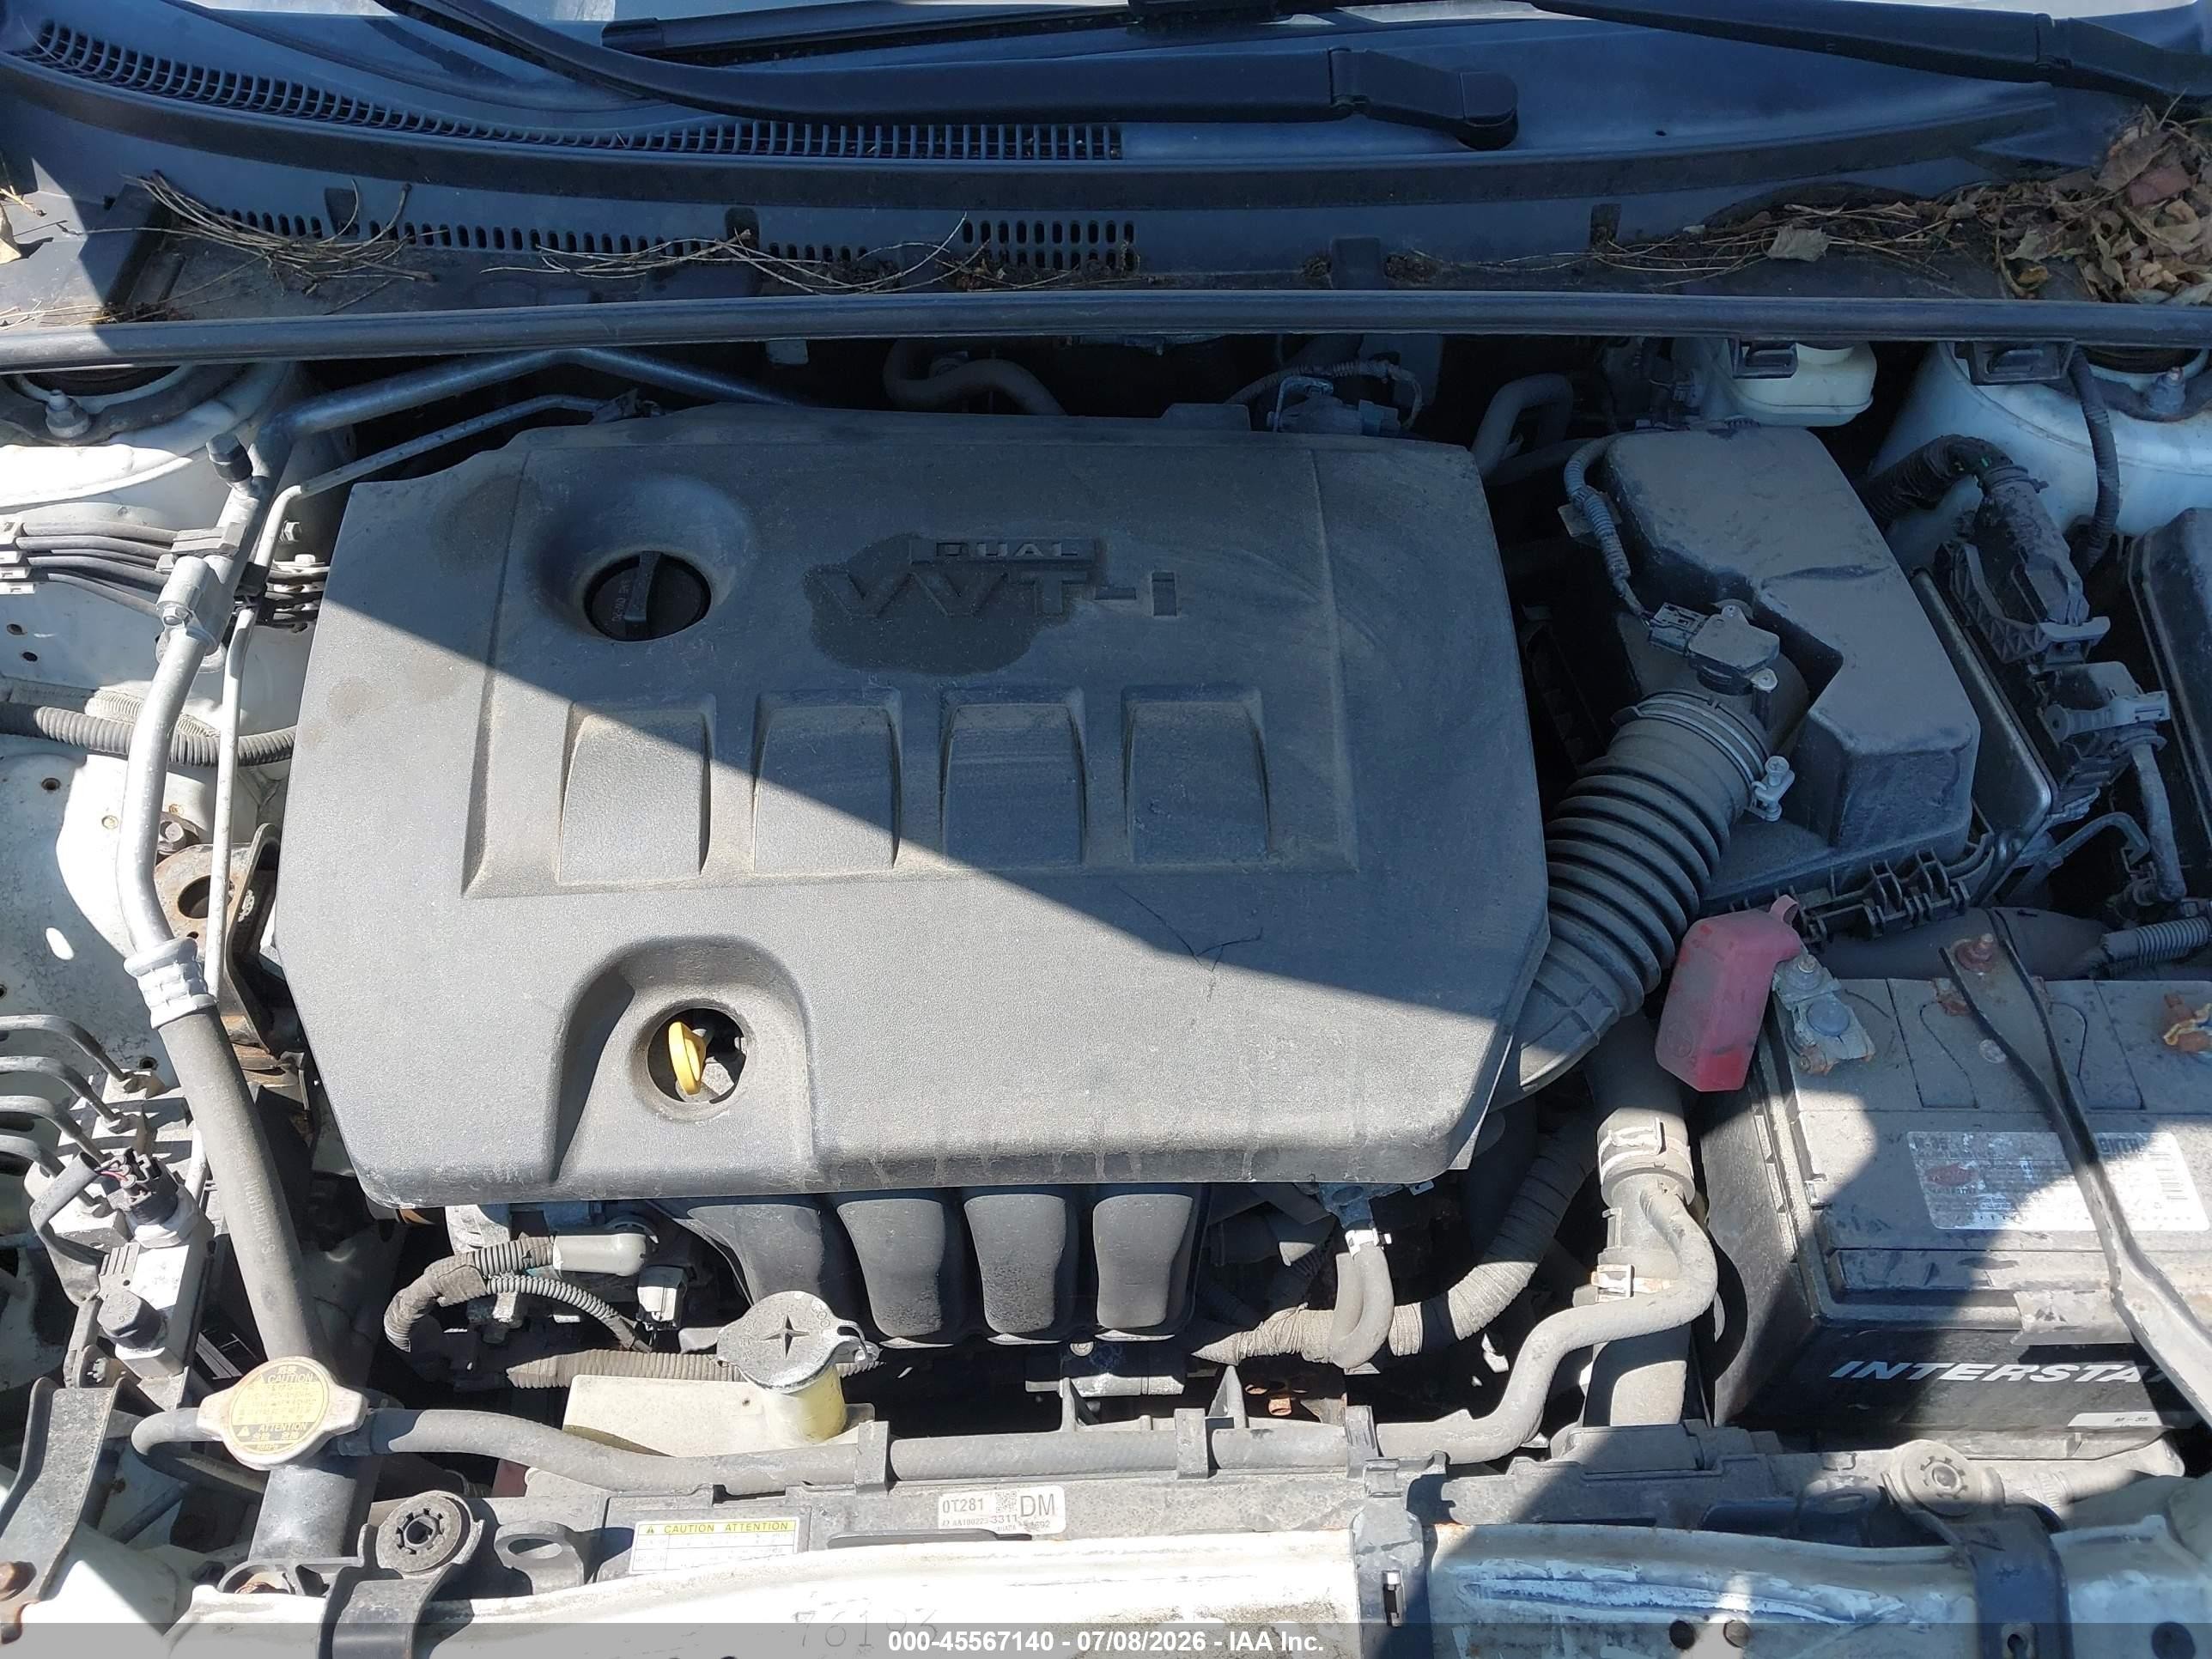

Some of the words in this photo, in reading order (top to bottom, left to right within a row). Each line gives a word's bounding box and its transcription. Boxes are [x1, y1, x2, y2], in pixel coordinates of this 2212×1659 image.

[935, 541, 1079, 558] DUAL
[267, 1373, 314, 1383] CAUTION
[1828, 1360, 2163, 1382] INTERSTA
[257, 1422, 307, 1432] ATTENTION
[1020, 1492, 1055, 1517] DM
[664, 1524, 715, 1534] CAUTION
[724, 1522, 788, 1533] ATTENTION
